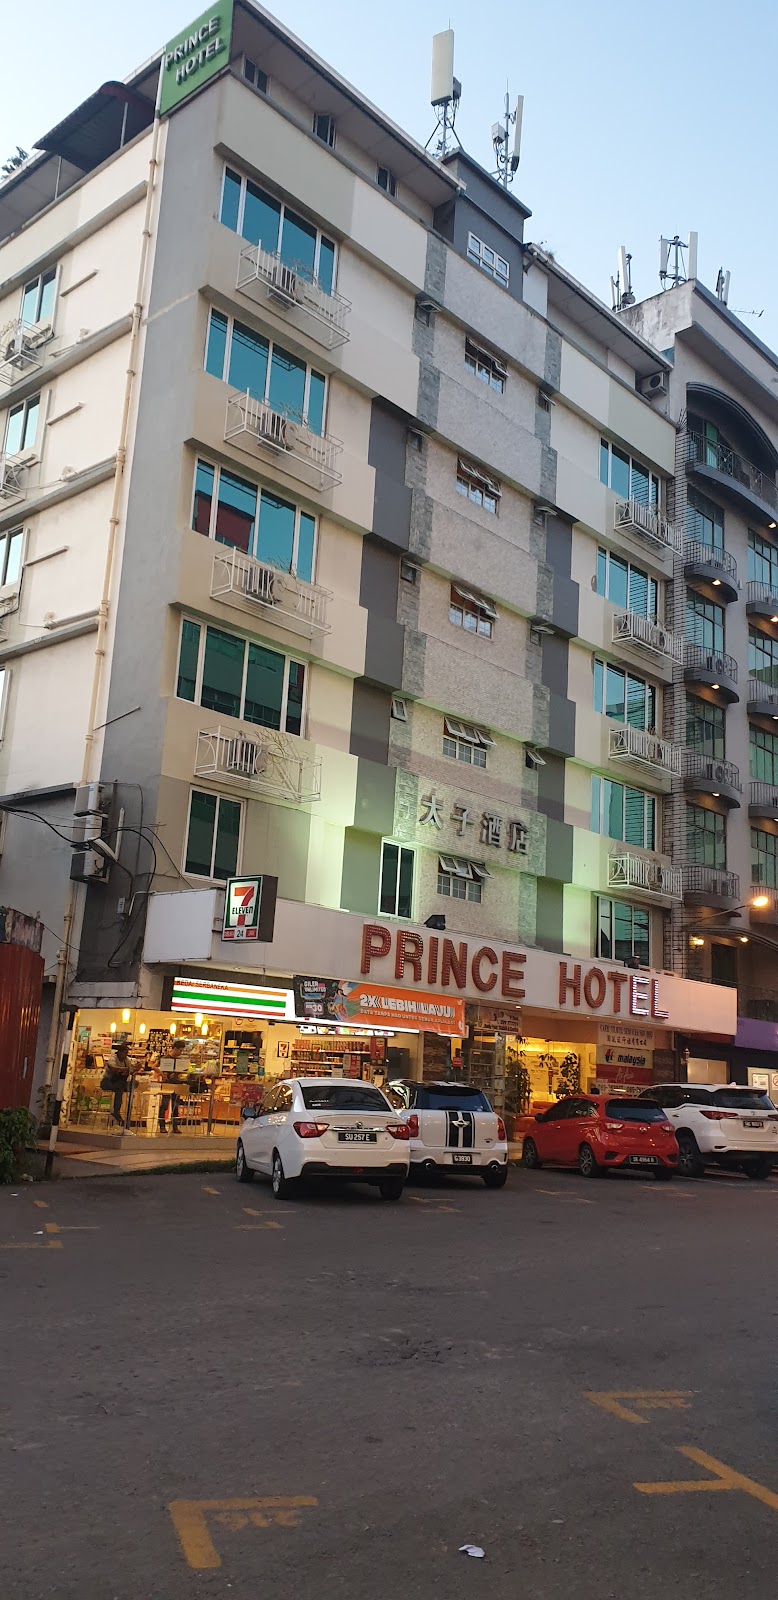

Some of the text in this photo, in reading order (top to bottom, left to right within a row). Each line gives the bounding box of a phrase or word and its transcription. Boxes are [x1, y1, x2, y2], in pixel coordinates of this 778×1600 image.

[164, 14, 221, 71] PRINCE
[176, 37, 226, 85] HOTEL
[419, 790, 529, 854] 太子酒店
[234, 886, 254, 926] 7
[236, 930, 244, 938] 24
[361, 924, 669, 1018] PRINCE HOTEL
[381, 996, 417, 1014] LEBIH
[420, 1002, 452, 1018] LAJU
[617, 1054, 646, 1066] malaysia
